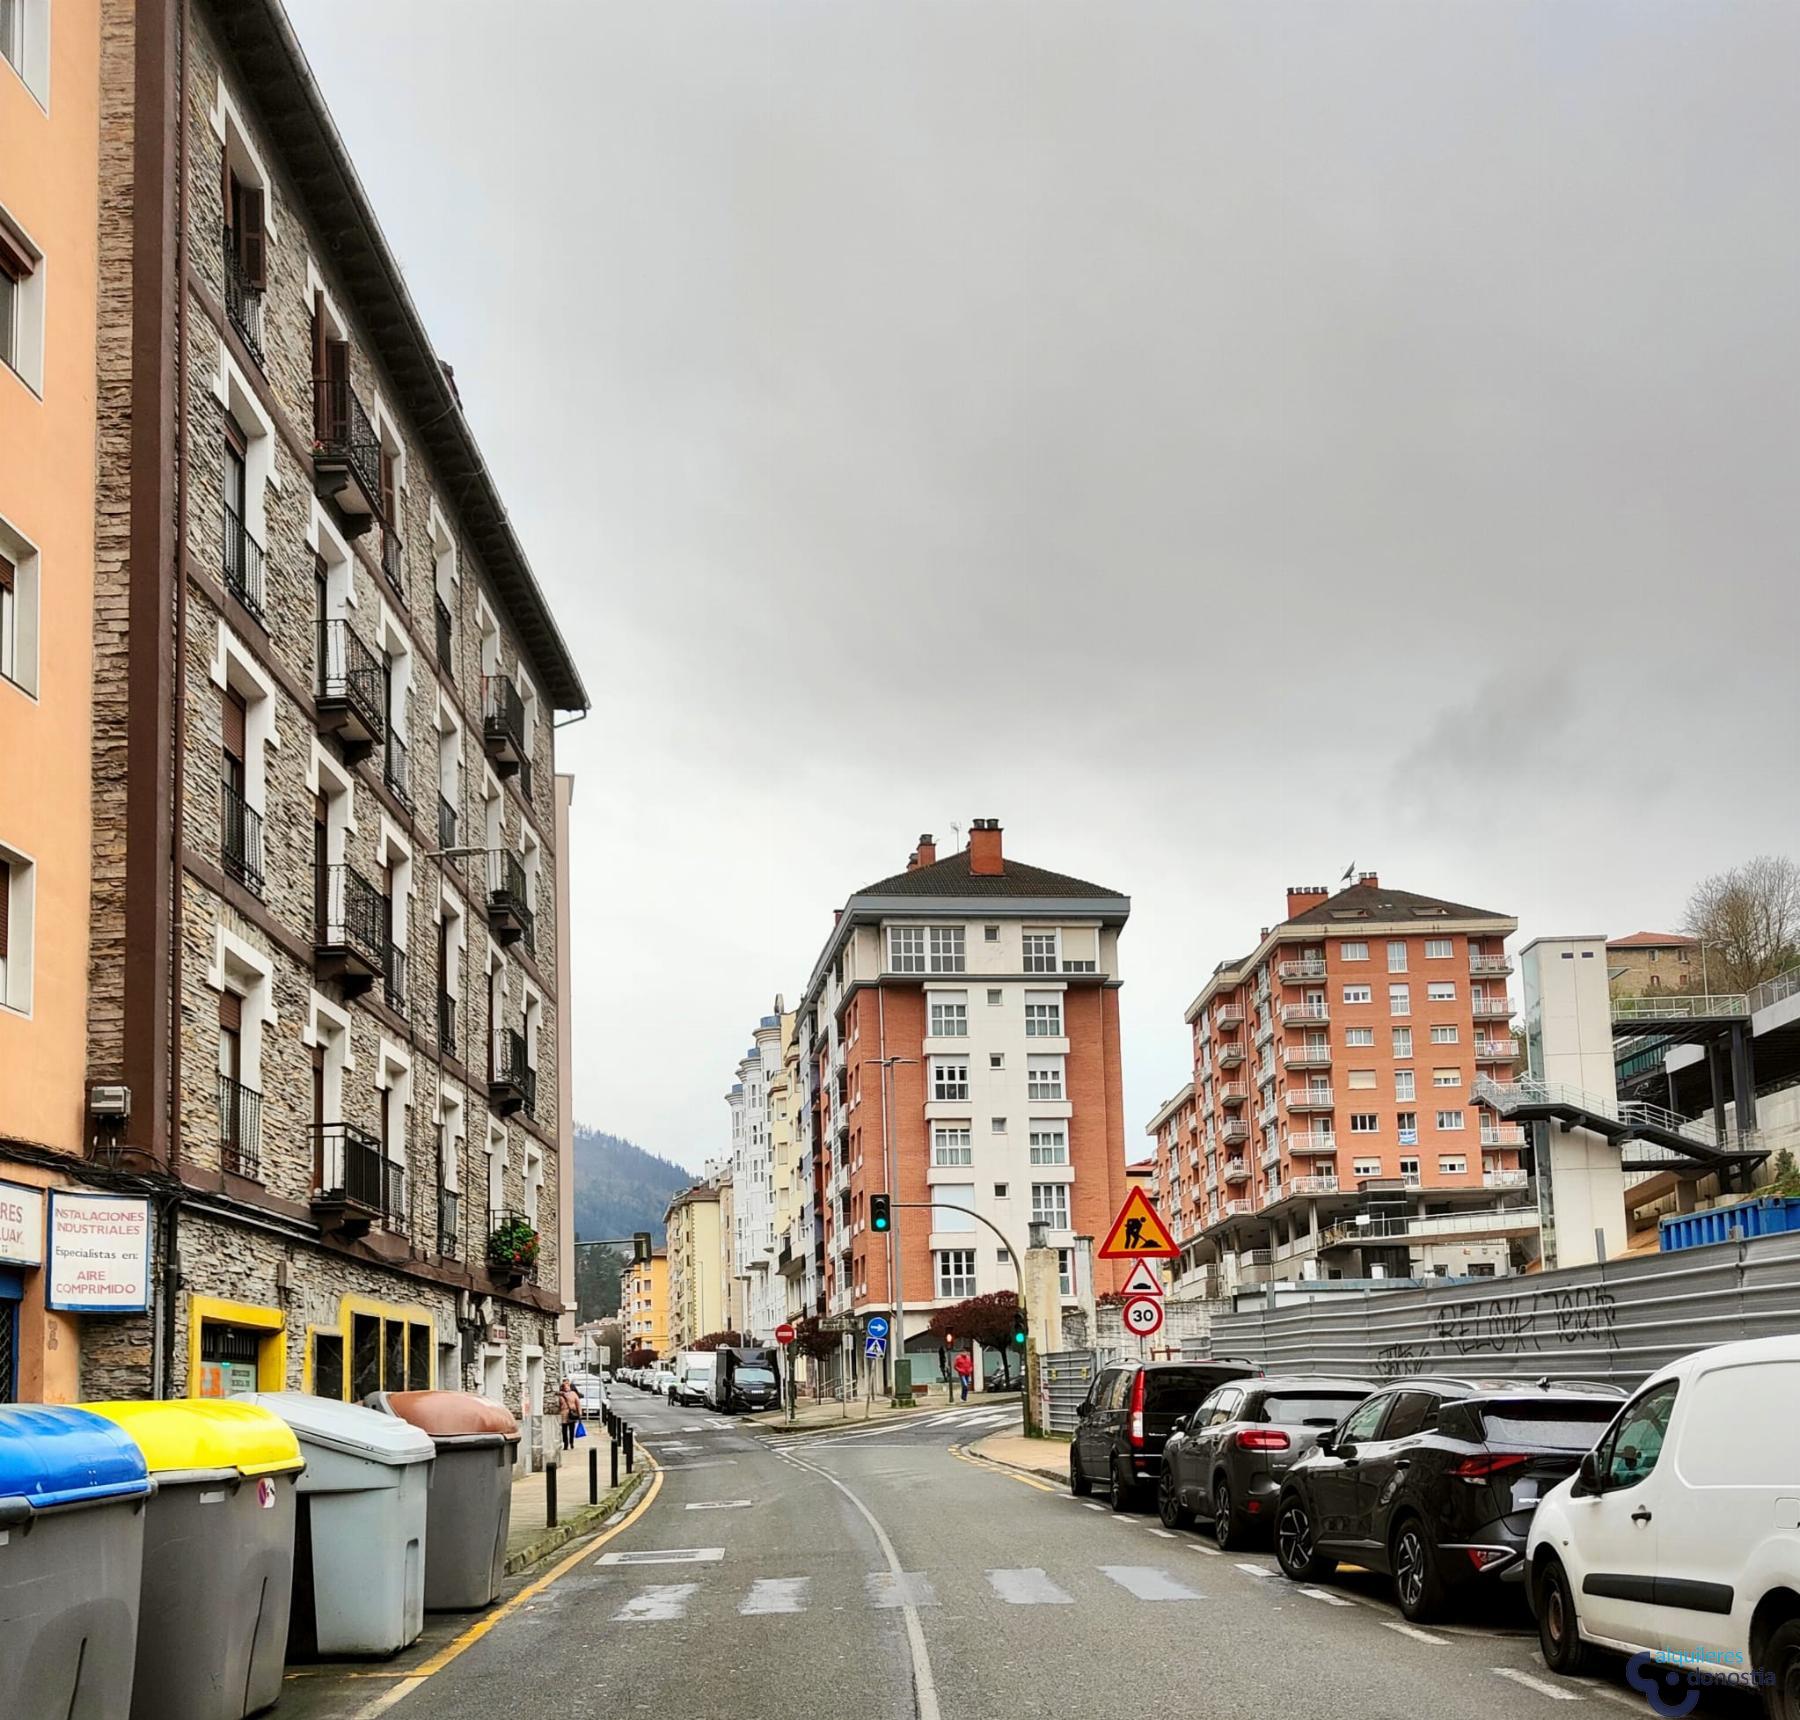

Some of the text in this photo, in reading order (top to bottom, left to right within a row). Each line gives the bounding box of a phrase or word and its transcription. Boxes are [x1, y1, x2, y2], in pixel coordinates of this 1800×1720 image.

[55, 1207, 145, 1222] NSTALACIONES
[57, 1222, 140, 1235] INDUSTRIALES
[55, 1246, 116, 1260] Especialistas
[77, 1271, 106, 1280] AIRE
[56, 1284, 136, 1294] COMPRIMIDO
[1132, 1309, 1154, 1322] 30
